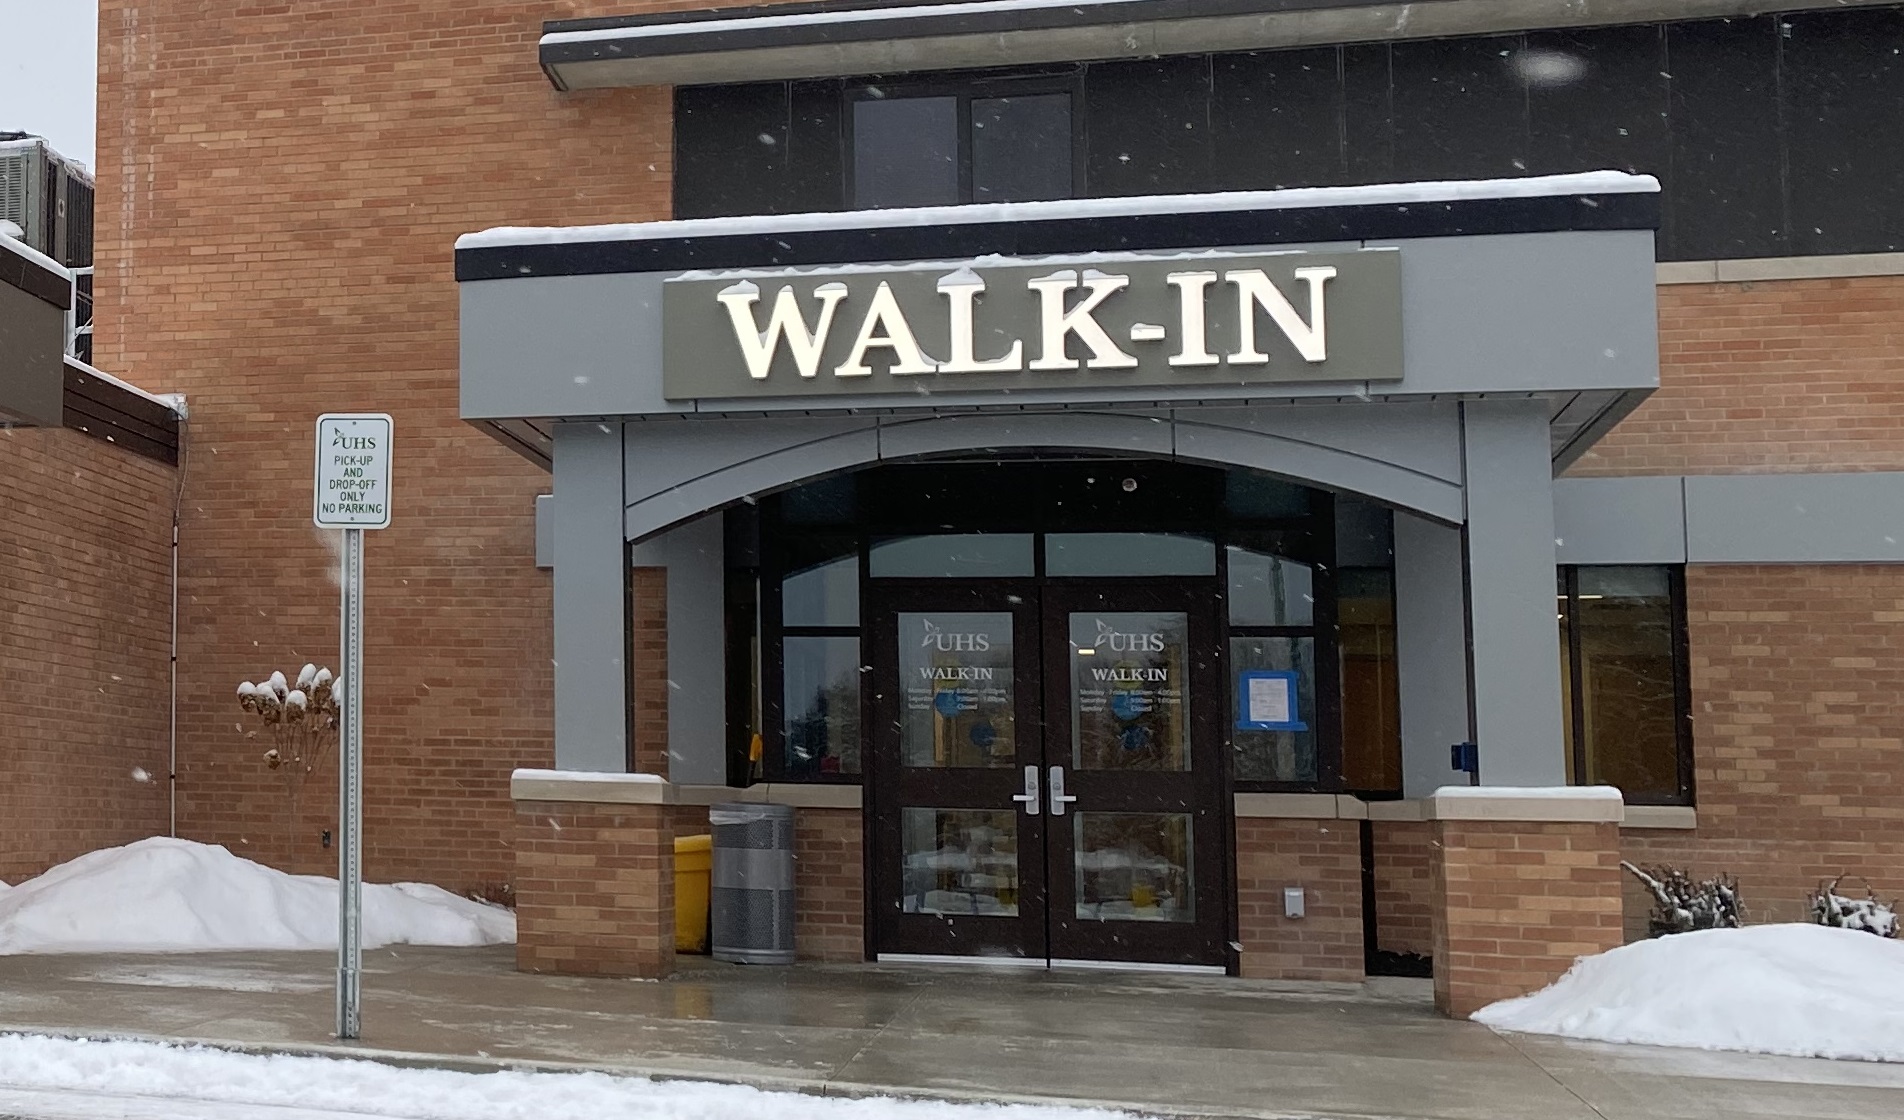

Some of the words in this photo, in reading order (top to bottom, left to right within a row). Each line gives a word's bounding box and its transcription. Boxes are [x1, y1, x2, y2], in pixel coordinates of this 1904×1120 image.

[717, 266, 1337, 378] WALK-IN
[342, 437, 377, 450] UHS
[334, 455, 374, 466] PICK-UP
[343, 467, 364, 478] AND
[329, 479, 377, 490] DROP-OFF
[340, 491, 366, 502] ONLY
[322, 503, 336, 513] NO
[338, 503, 383, 514] PARKING
[936, 633, 990, 652] UHS
[1109, 633, 1165, 652] UHS
[919, 667, 993, 680] WALK-IN
[1091, 668, 1168, 681] WALK-IN
